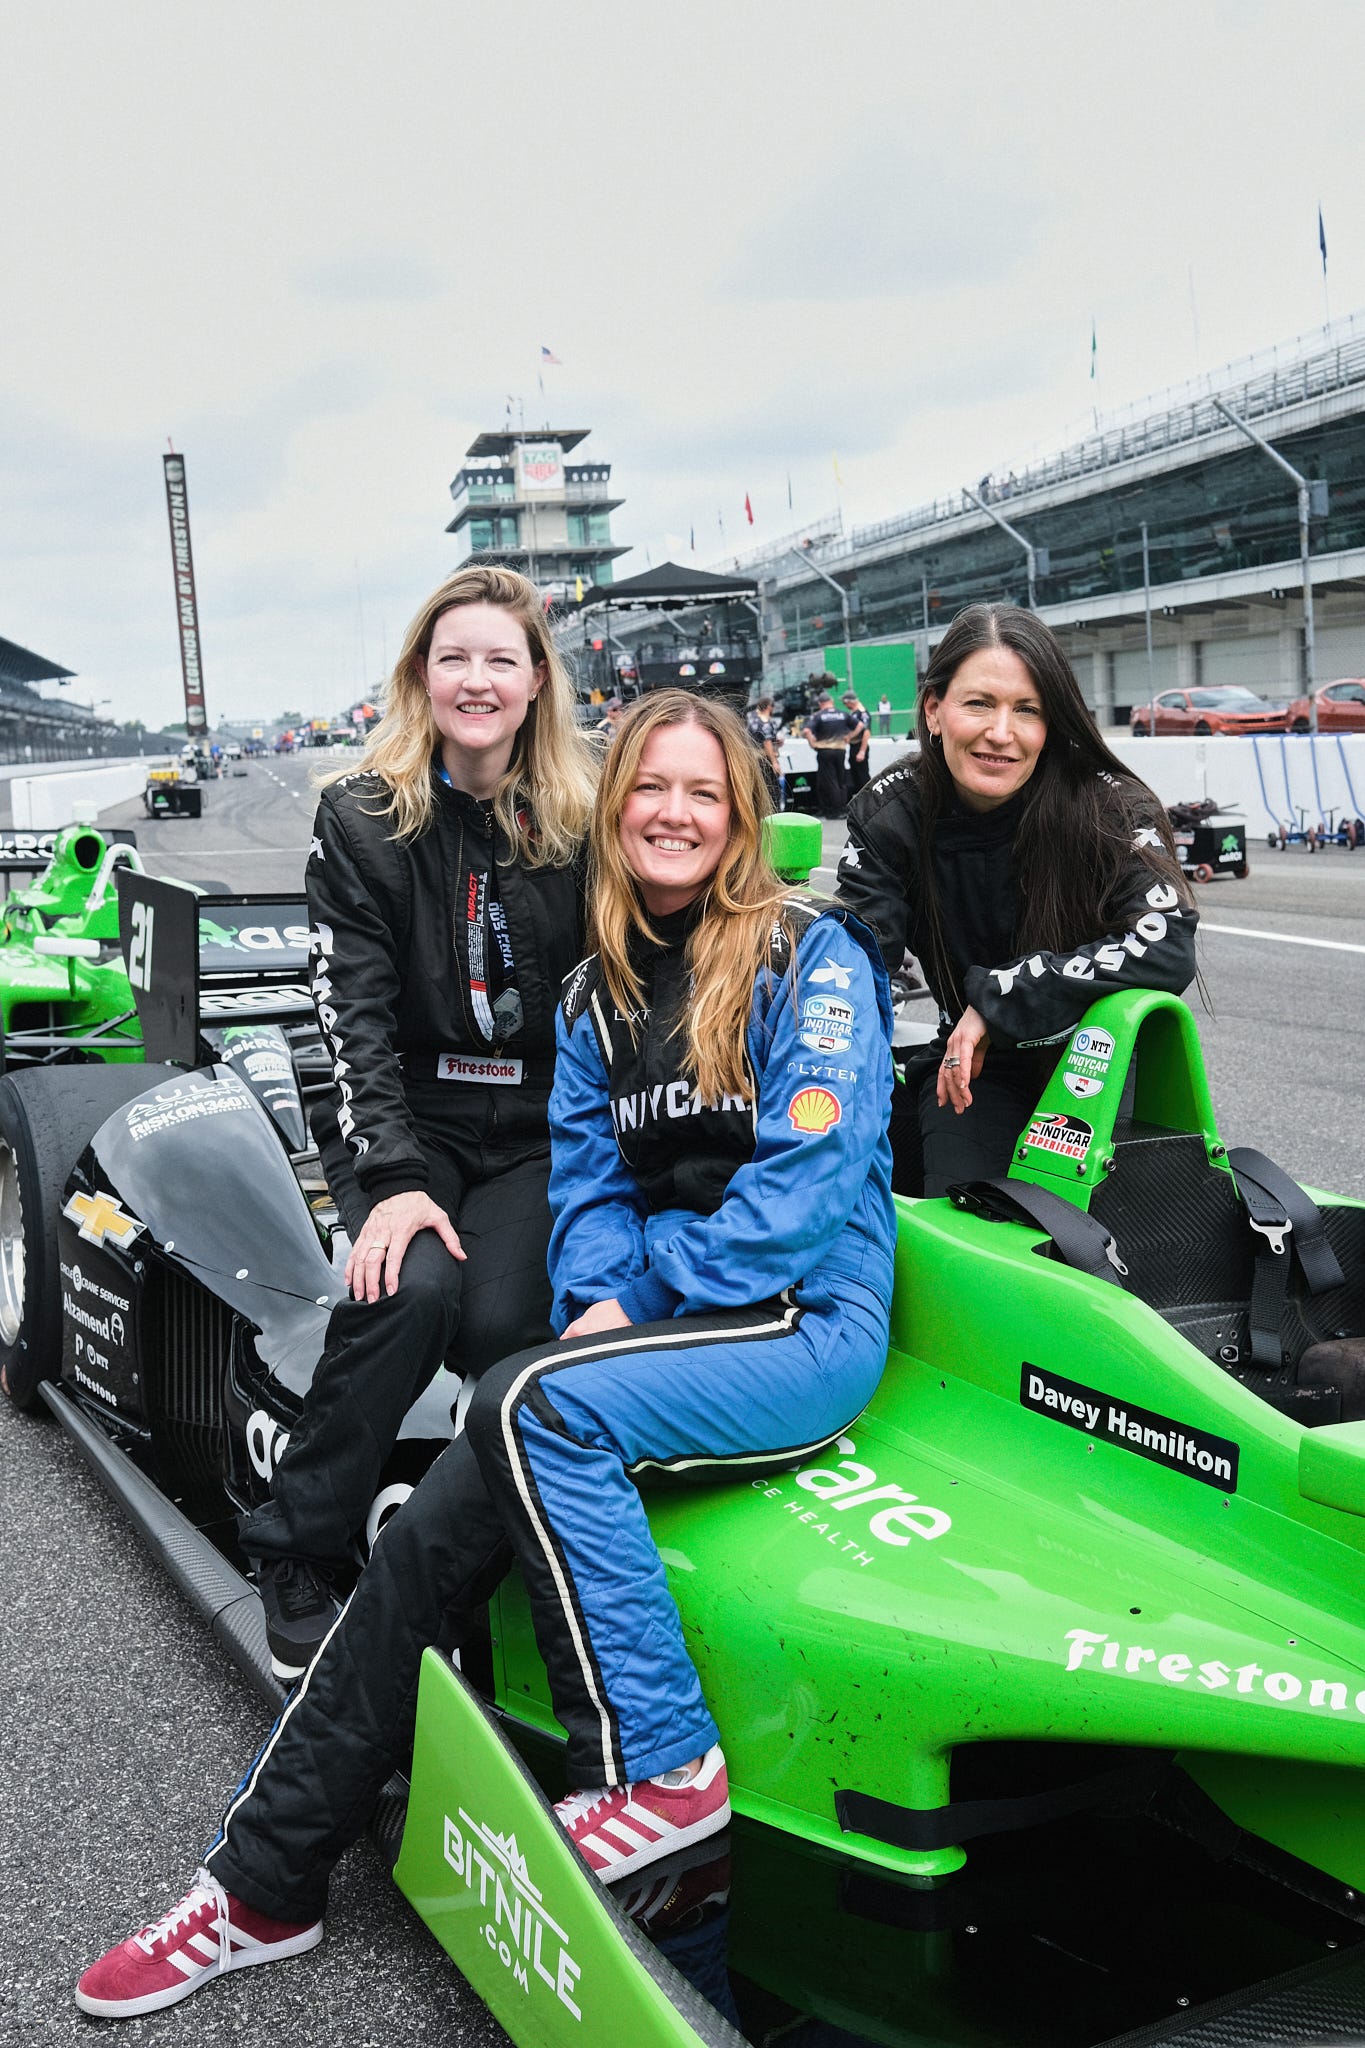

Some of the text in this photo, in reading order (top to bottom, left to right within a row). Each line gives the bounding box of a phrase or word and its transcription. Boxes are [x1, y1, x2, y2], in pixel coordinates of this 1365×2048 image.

[524, 451, 556, 463] TAG
[171, 483, 201, 695] LEGENDS DAY BY FIRESTONE
[467, 872, 478, 922] IMPACT
[129, 901, 154, 992] 21
[565, 963, 589, 1018] IMPACT
[828, 1006, 851, 1019] NTT
[803, 1018, 852, 1036] INDYCAR
[1090, 1040, 1111, 1054] NTT
[445, 1057, 516, 1078] Firestone
[799, 1063, 858, 1083] LYTEN
[1067, 1054, 1109, 1074] INDYCAR
[1073, 1065, 1098, 1078] SERIES
[1024, 1133, 1087, 1159] EXPERIENCE
[1039, 1125, 1091, 1148] INDYCAR
[60, 1261, 74, 1280] CIRCLE
[81, 1277, 99, 1296] CRANE
[99, 1287, 130, 1312] SERVICES
[63, 1291, 110, 1341] Alzamend
[74, 1364, 118, 1407] Firestone
[1028, 1374, 1232, 1481] Davey Hamilton
[751, 1479, 875, 1567] CE HEALTH
[1064, 1628, 1365, 1716] Fireston
[443, 1814, 582, 2022] BITNILE
[478, 1923, 530, 1995] .COM
